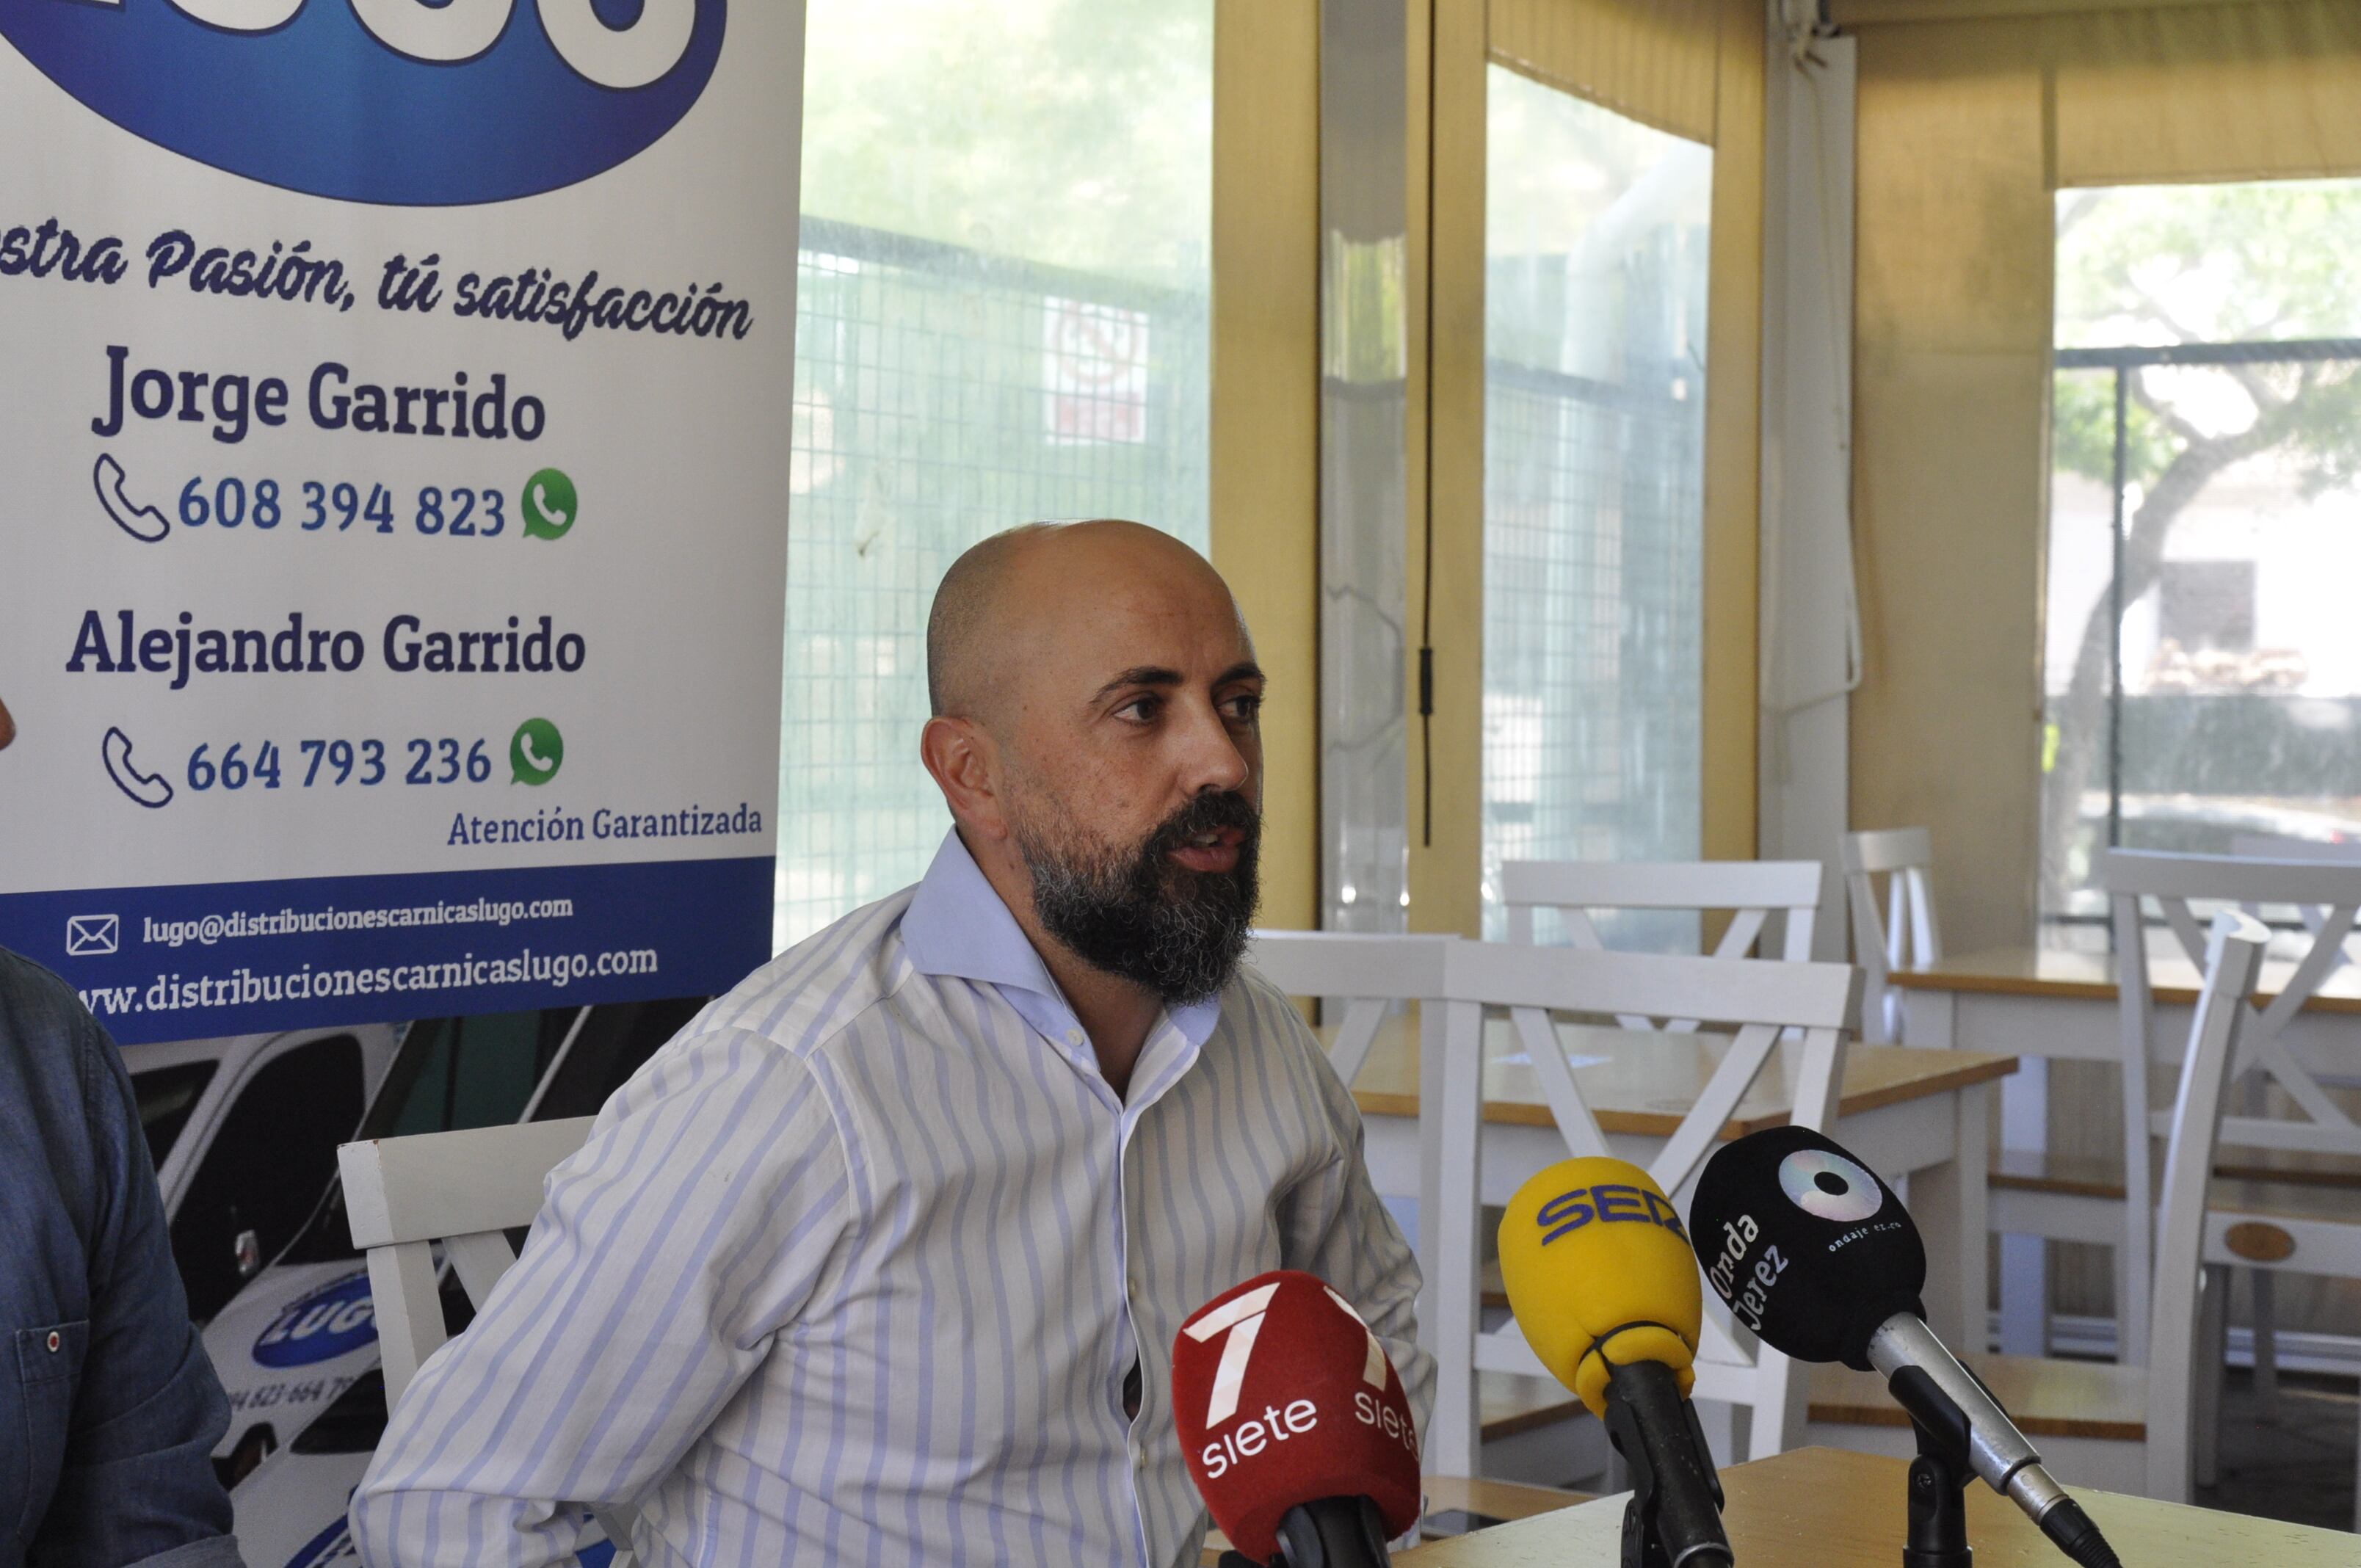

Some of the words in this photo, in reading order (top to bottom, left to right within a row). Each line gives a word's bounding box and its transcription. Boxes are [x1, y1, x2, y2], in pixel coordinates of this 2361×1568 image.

[0, 217, 128, 285] stra
[145, 229, 355, 313] Pasión,
[377, 253, 443, 313] tú
[453, 267, 754, 341] satisfacción
[91, 344, 289, 444] Jorge
[308, 362, 545, 441] Garrido
[178, 476, 281, 529] 608
[301, 481, 394, 534] 394
[416, 486, 505, 537] 823
[65, 609, 365, 690] Alejandro
[383, 614, 586, 672] Garrido
[187, 740, 281, 791] 664
[300, 738, 386, 787] 793
[405, 738, 491, 785] 236
[447, 806, 584, 846] Atención
[592, 802, 763, 840] Garantizada
[142, 897, 573, 948] lugo@distribucionescarnicaslugo.com
[1537, 1184, 1691, 1246] SER
[1710, 1214, 1759, 1299] Onda
[1733, 1244, 1789, 1331] Jerez
[259, 1295, 377, 1346] LUG
[1183, 1282, 1281, 1430] 7
[1202, 1399, 1318, 1479] siete
